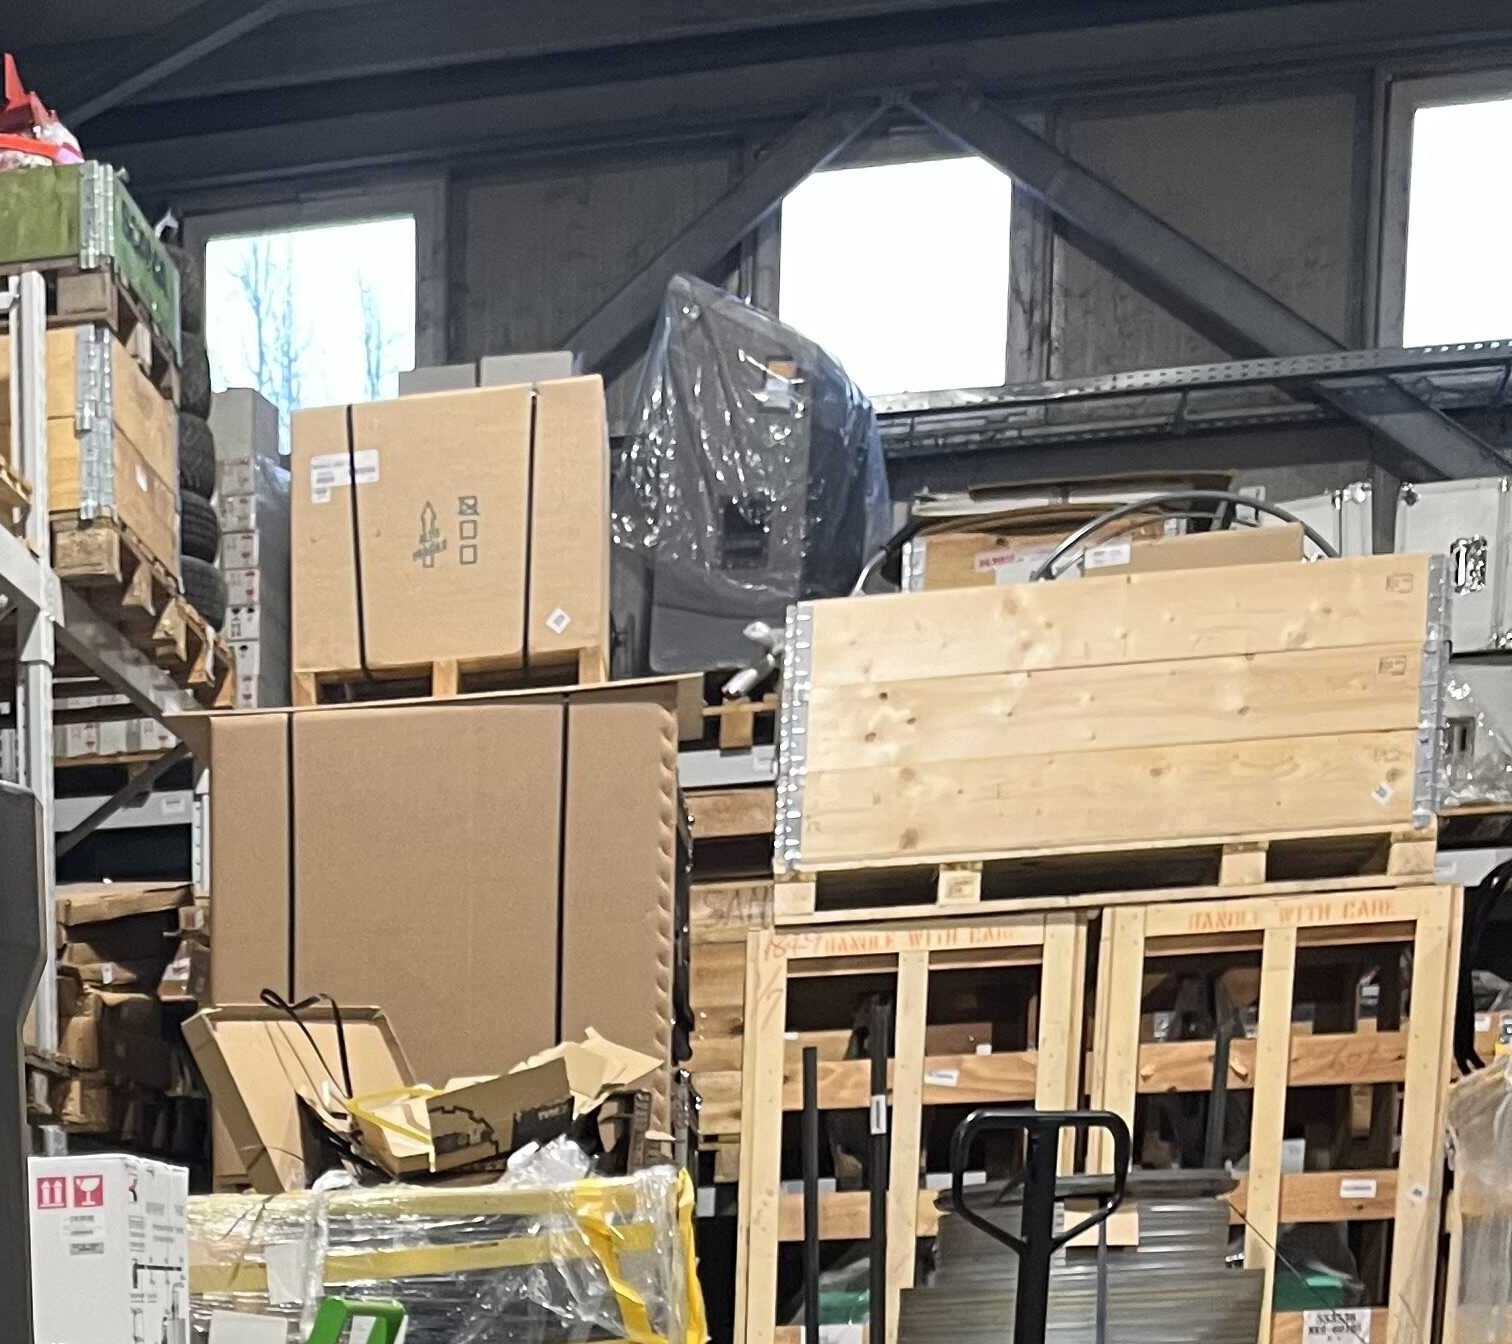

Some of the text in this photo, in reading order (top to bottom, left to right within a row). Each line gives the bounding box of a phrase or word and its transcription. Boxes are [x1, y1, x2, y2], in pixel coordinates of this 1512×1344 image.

[1279, 902, 1331, 925] WITH
[1343, 897, 1396, 920] CARE
[908, 928, 957, 948] WITH
